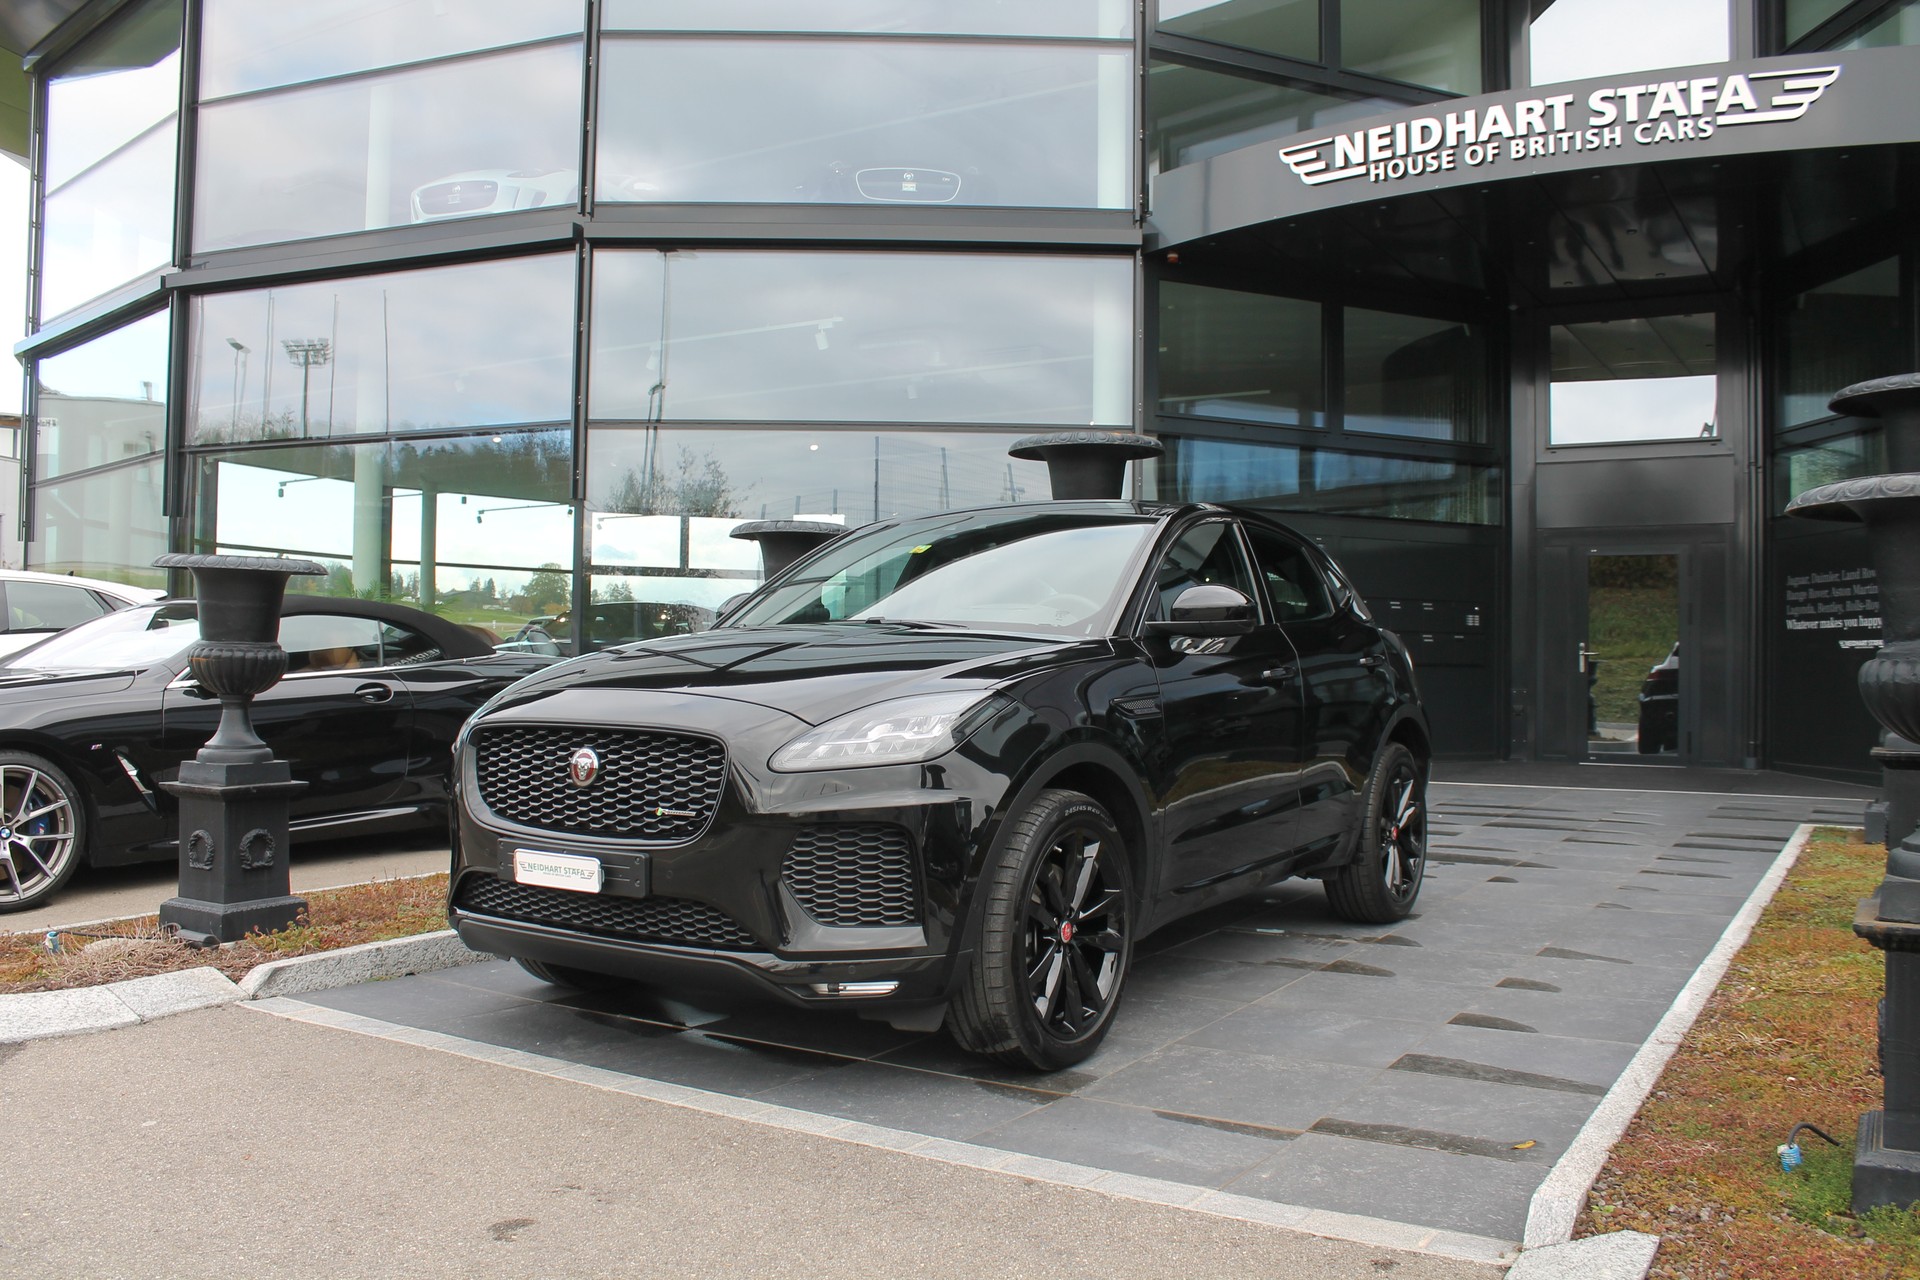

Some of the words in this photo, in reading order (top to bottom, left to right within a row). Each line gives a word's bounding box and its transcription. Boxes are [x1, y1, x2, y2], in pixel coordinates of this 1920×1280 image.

[1334, 94, 1574, 168] NEIDHART
[1588, 74, 1758, 126] STÄFA
[1369, 149, 1455, 182] HOUSE
[1464, 142, 1499, 166] OF
[1510, 126, 1622, 159] BRITISH
[1634, 117, 1714, 144] CARS
[1786, 619, 1819, 629] Whatever
[1819, 617, 1843, 629] makes
[1843, 618, 1858, 630] you
[527, 862, 562, 874] NEIDHART
[563, 867, 586, 877] STÄFA
